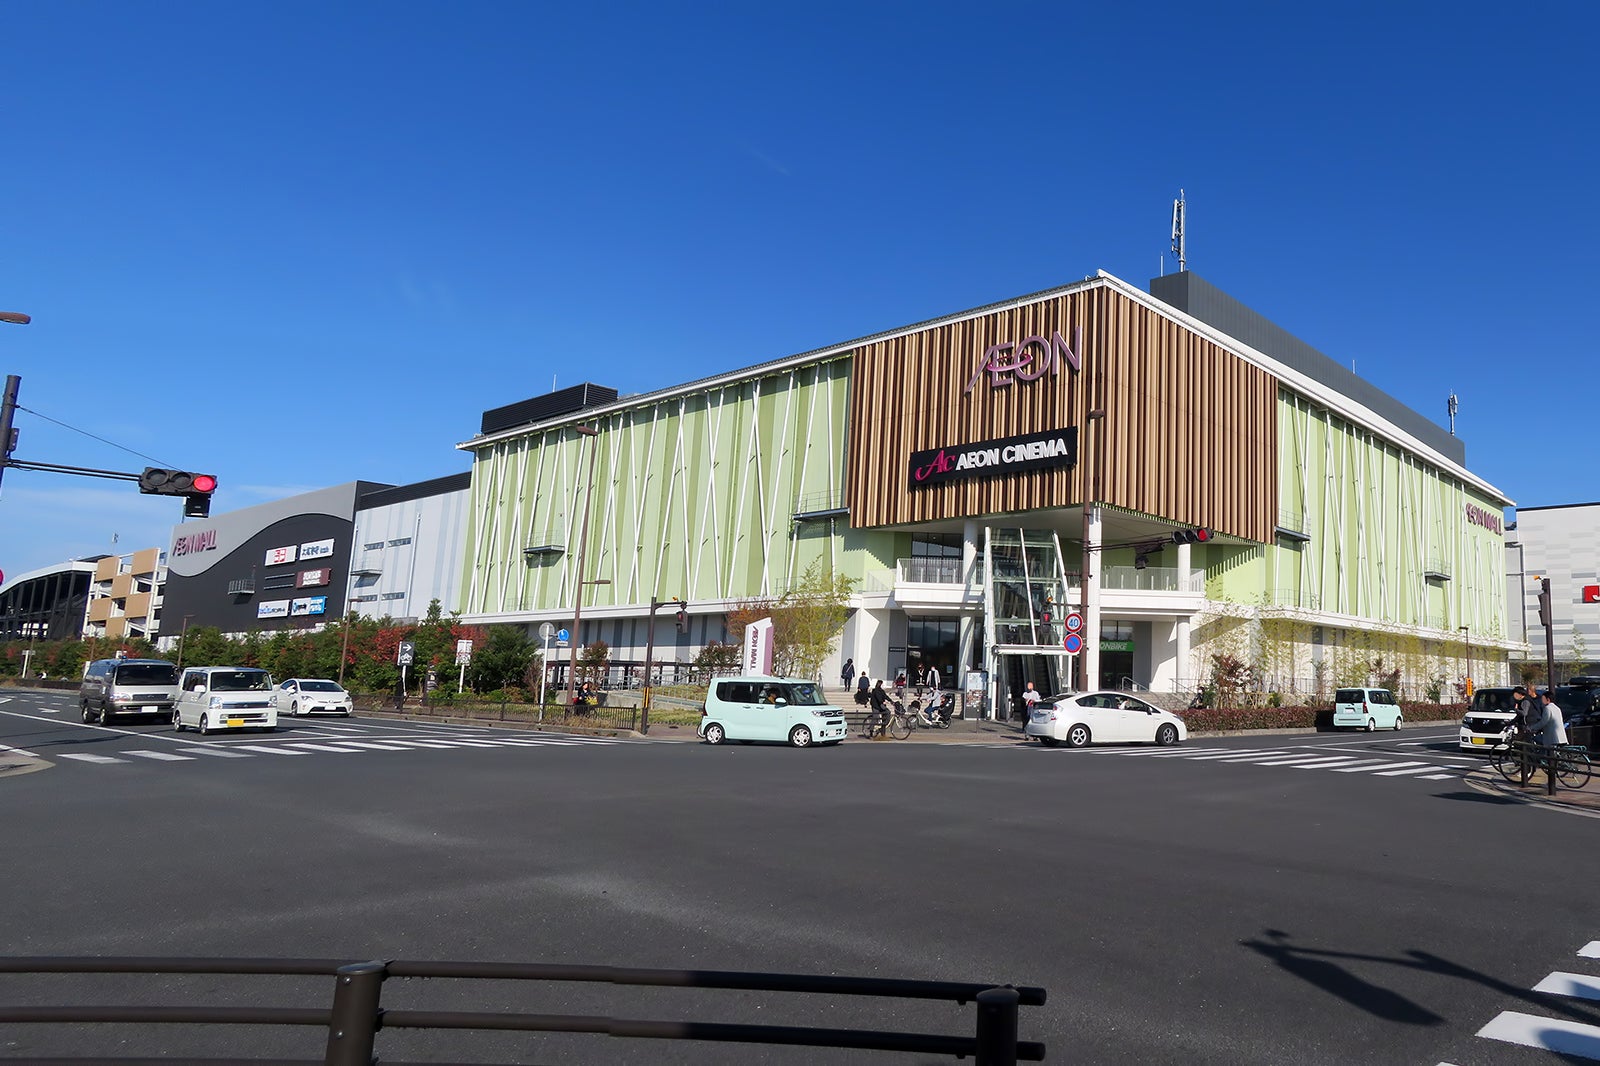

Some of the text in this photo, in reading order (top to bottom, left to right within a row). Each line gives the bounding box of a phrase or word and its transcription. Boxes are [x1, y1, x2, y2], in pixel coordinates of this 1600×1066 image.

[956, 448, 999, 471] AEON
[1002, 438, 1068, 463] CINEMA
[1069, 618, 1079, 627] 40
